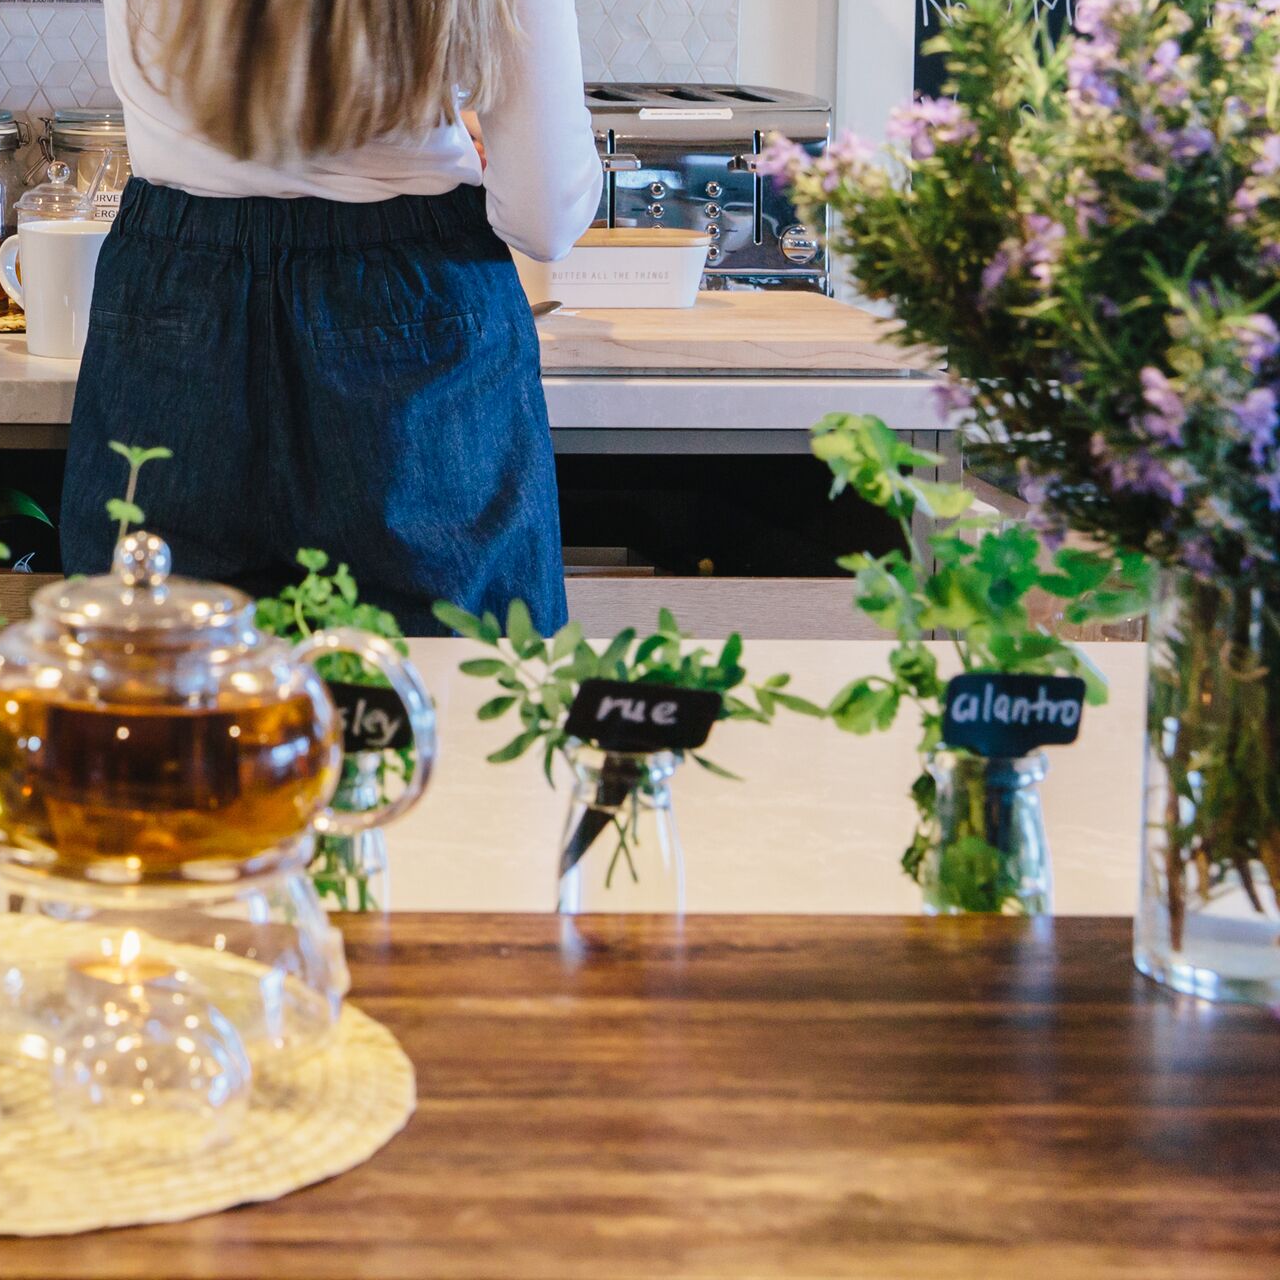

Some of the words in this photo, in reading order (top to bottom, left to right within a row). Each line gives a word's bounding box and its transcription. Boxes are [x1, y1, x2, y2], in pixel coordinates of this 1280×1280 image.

[552, 272, 587, 280] BUTTER
[591, 272, 608, 280] ALL
[613, 272, 630, 280] THE
[635, 272, 669, 280] THINGS
[596, 696, 678, 724] rue
